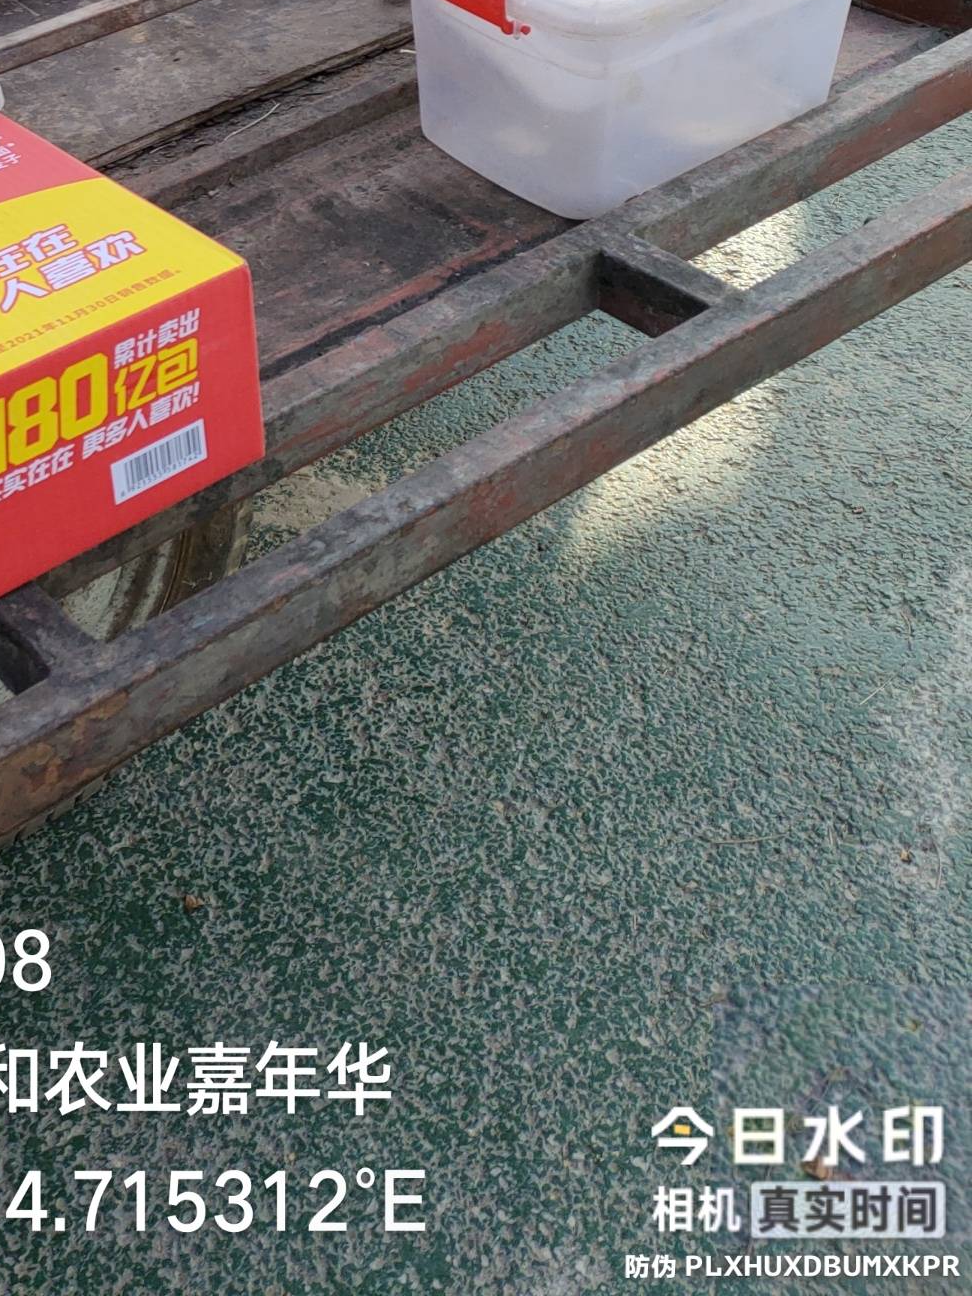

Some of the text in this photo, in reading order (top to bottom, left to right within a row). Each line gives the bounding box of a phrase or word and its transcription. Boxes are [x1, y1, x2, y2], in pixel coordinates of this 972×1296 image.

[114, 308, 201, 369] 累计卖出
[114, 337, 198, 416] 亿包
[81, 382, 201, 460] 更多人喜欢!
